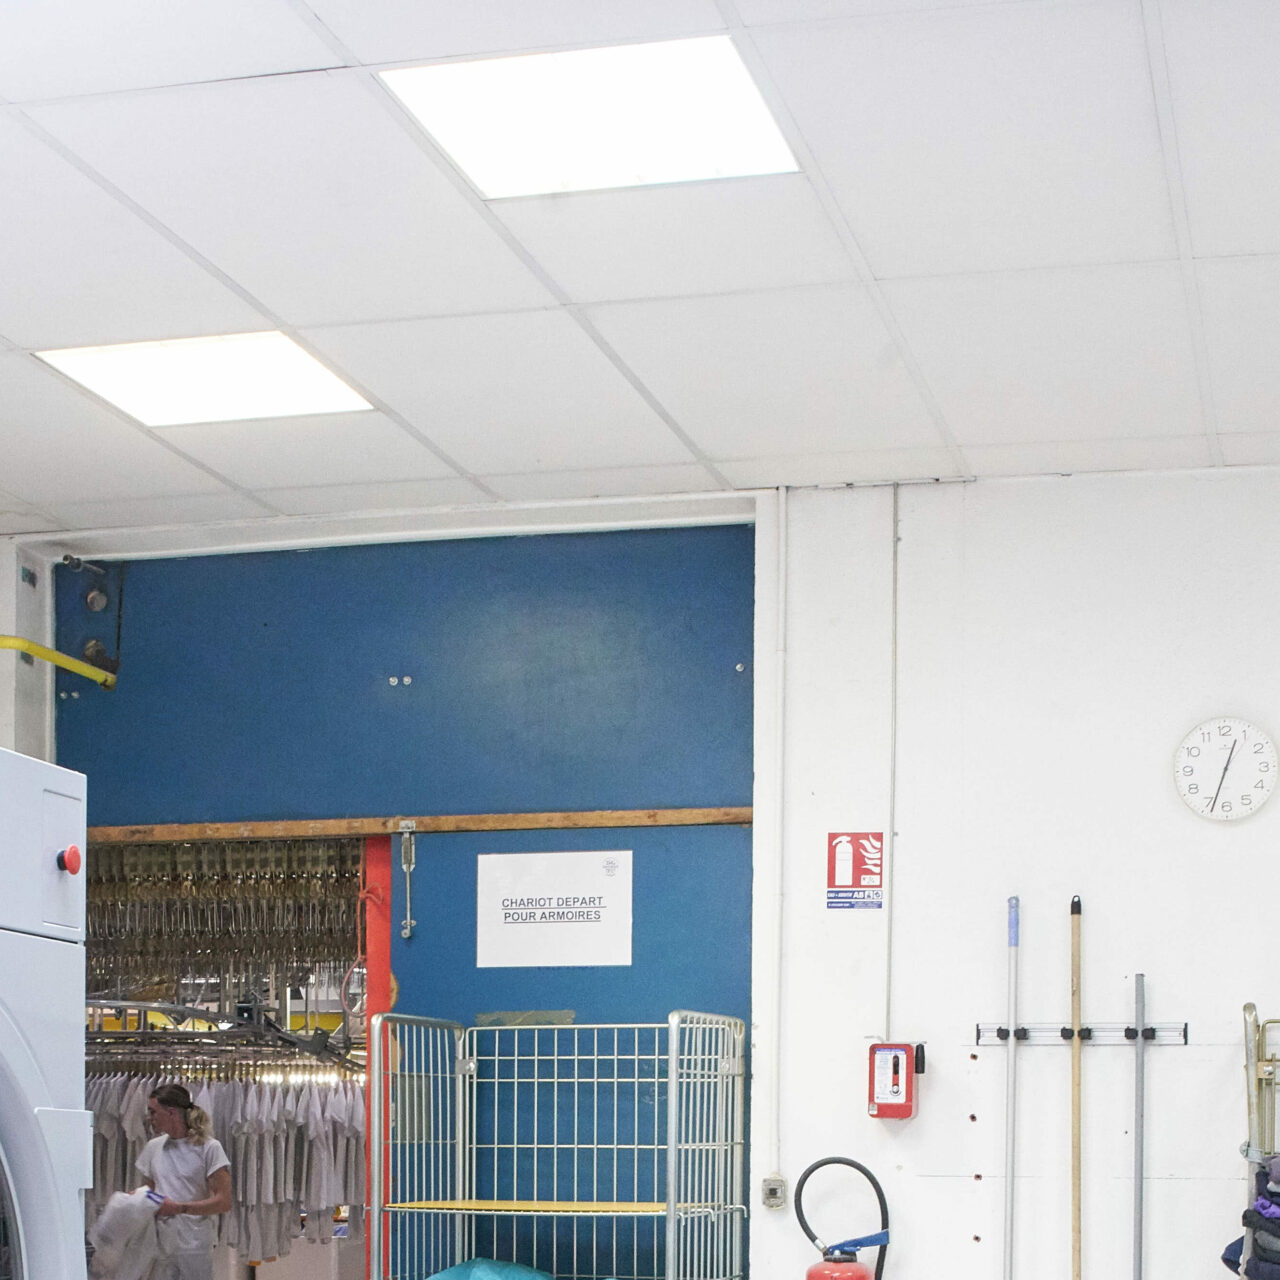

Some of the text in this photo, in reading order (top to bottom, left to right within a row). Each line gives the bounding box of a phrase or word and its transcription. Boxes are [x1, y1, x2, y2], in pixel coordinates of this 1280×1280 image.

[1217, 725, 1232, 736] 12
[1242, 729, 1247, 741] 1
[1201, 731, 1211, 743] 11
[1186, 746, 1201, 757] 10
[1253, 742, 1264, 754] 2
[1182, 765, 1194, 776] 9
[1258, 761, 1270, 773] 3
[1187, 783, 1199, 794] 8
[1253, 779, 1264, 790] 4
[1204, 796, 1214, 808] 7
[1241, 794, 1252, 806] 5
[1221, 801, 1232, 812] 6
[502, 896, 604, 908] CHARIOT DEPART
[504, 910, 601, 922] POUR ARMOIRES
